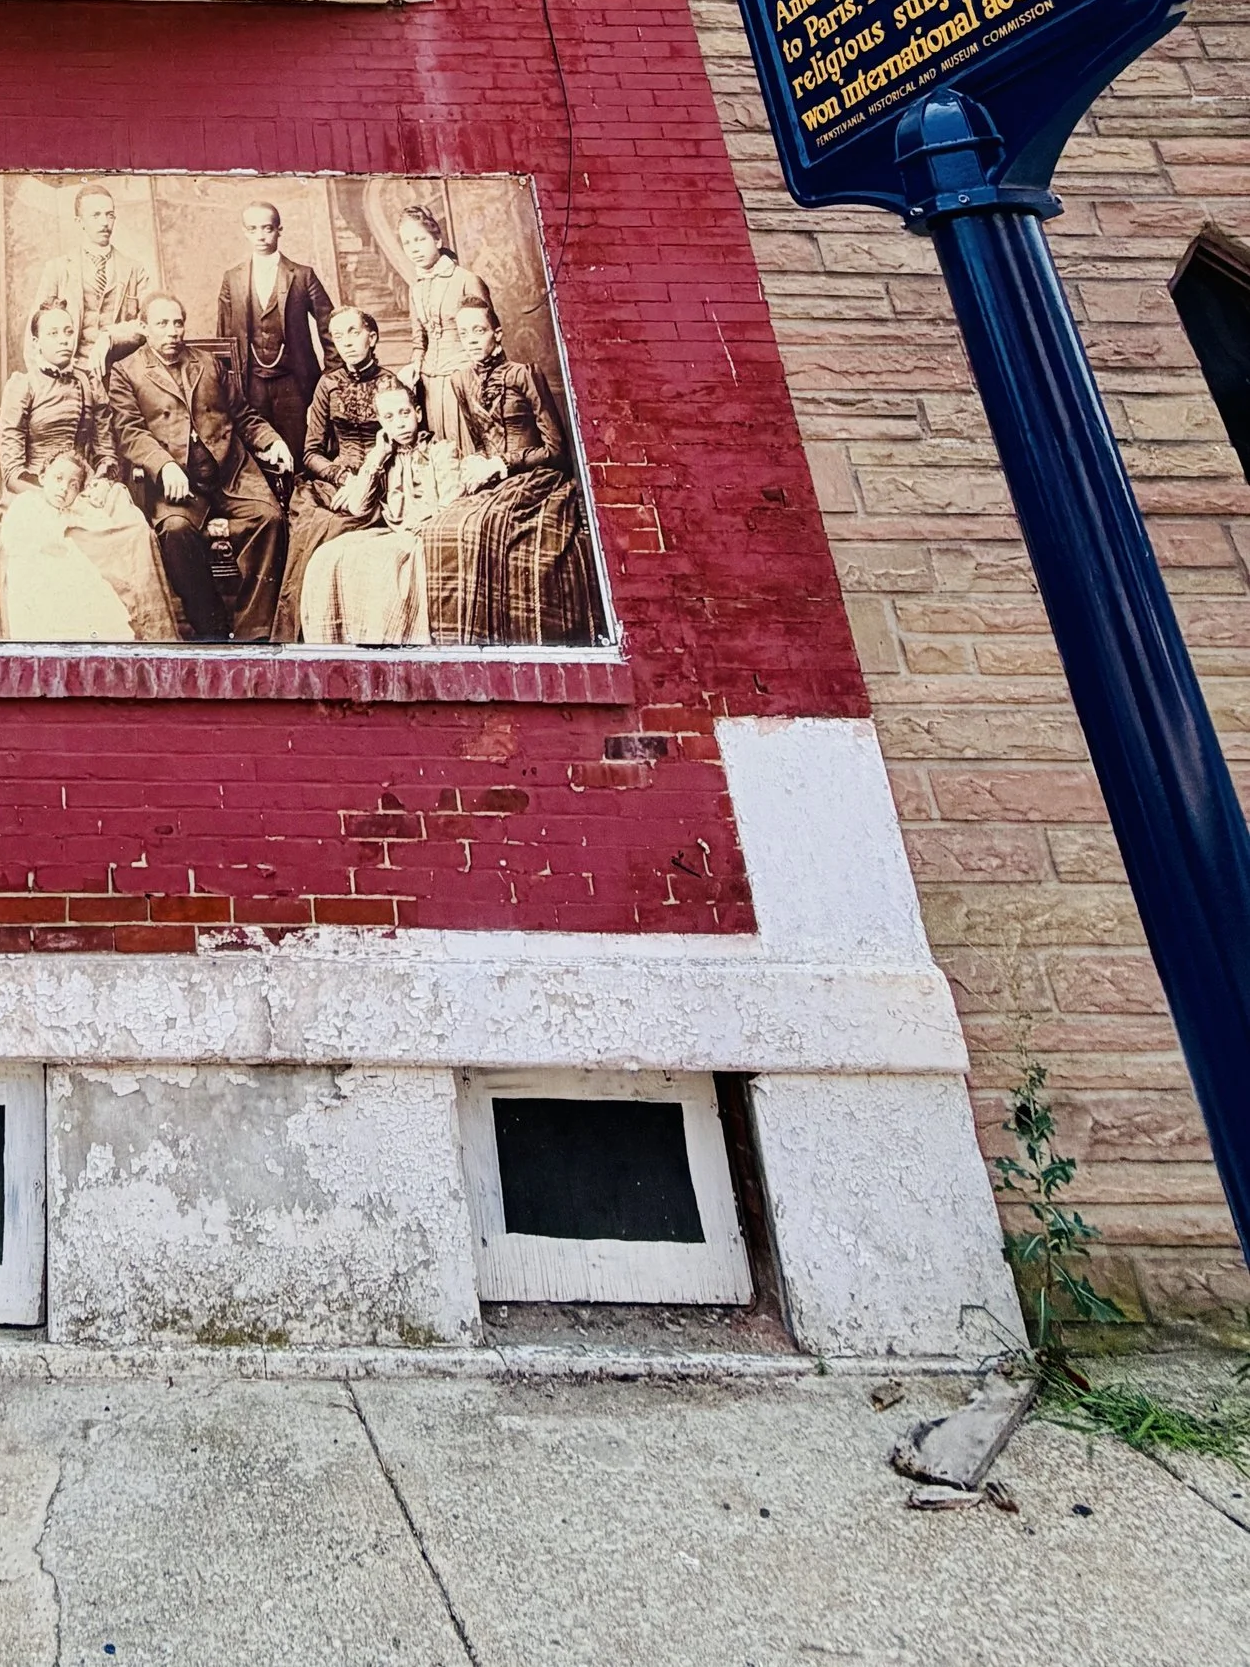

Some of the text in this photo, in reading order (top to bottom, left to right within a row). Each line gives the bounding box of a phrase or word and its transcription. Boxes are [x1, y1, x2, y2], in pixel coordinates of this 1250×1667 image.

[782, 38, 803, 64] to
[792, 19, 886, 100] religious
[801, 99, 841, 133] won
[816, 111, 867, 148] PENNSYLVANIA
[868, 81, 917, 117] HISTORICAL
[918, 67, 937, 86] AND
[940, 41, 980, 73] MUSEUM
